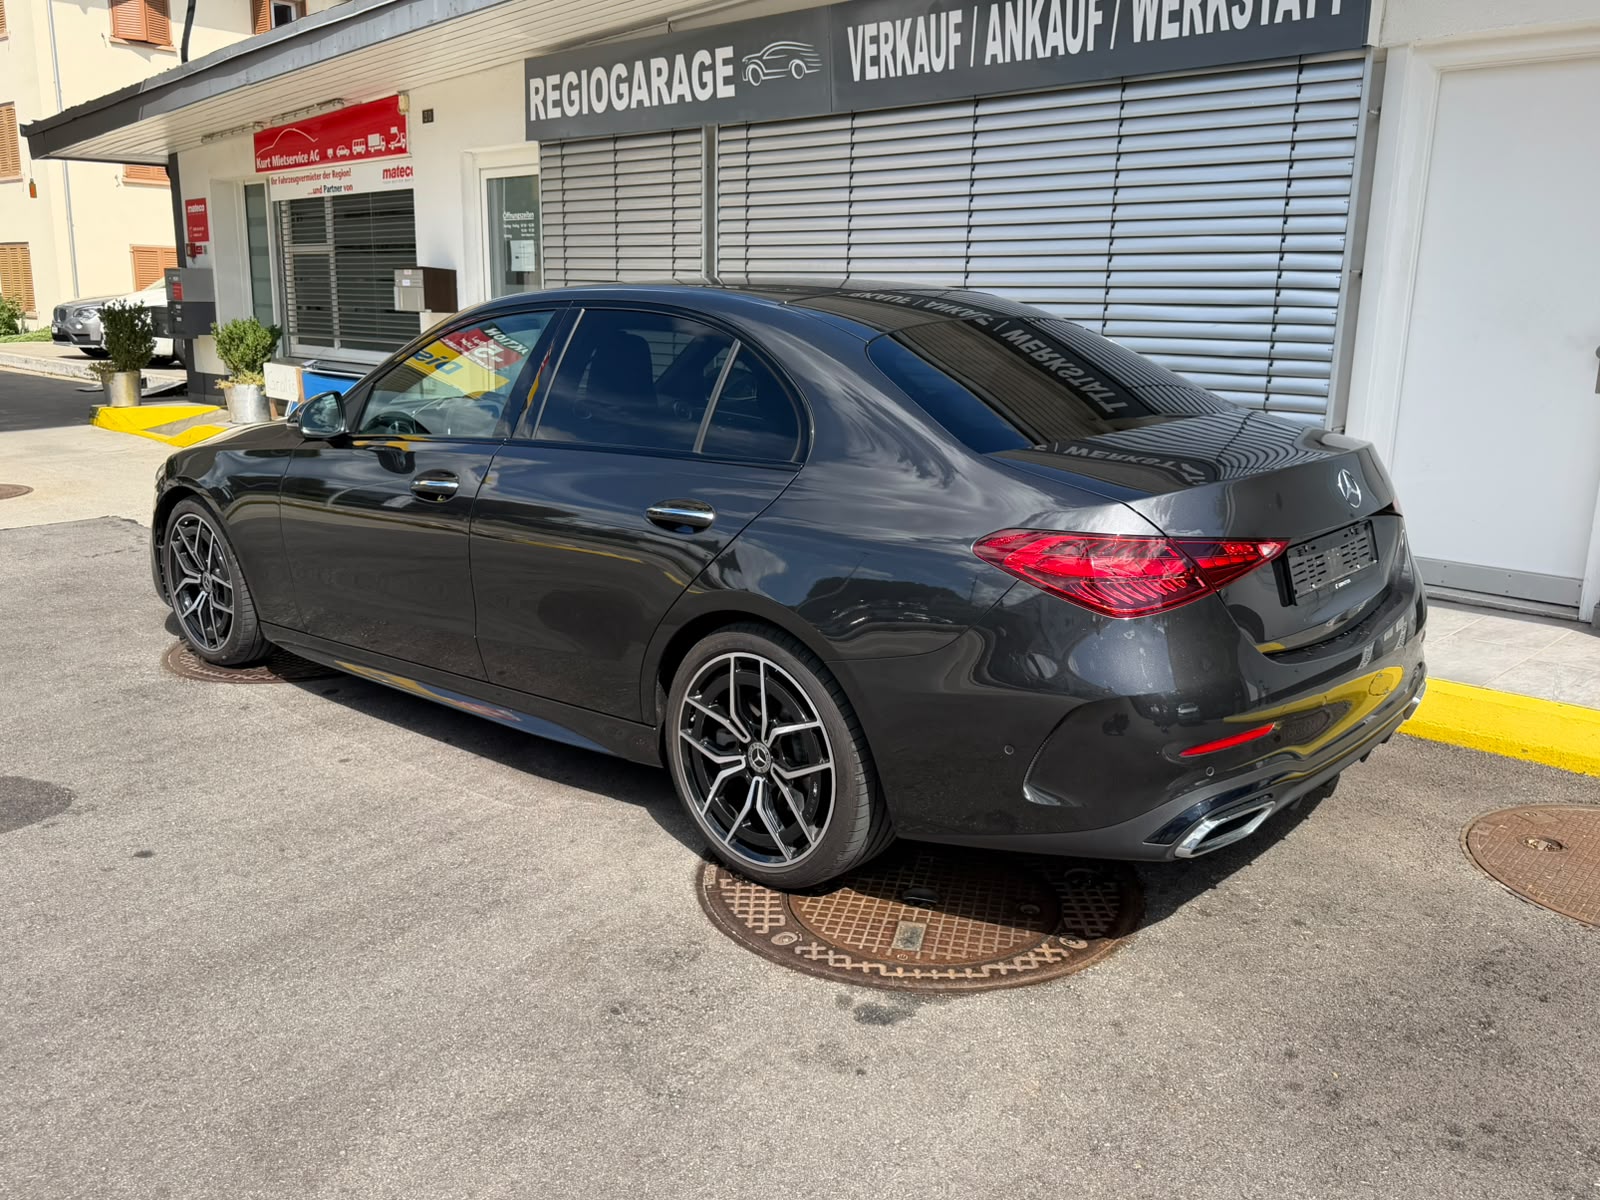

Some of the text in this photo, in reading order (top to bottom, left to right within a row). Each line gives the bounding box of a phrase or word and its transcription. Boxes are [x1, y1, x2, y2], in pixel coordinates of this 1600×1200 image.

[847, 9, 963, 82] VERKAUF
[984, 0, 1104, 66] ANKAUF
[1131, 0, 1342, 43] WERKS
[529, 45, 736, 121] REGIOGARAGE
[256, 149, 320, 169] Kurt Mietservice AG
[270, 167, 352, 185] Ihr Fahrzeugvermieter der Region!
[323, 184, 343, 193] Partner
[343, 184, 354, 192] von
